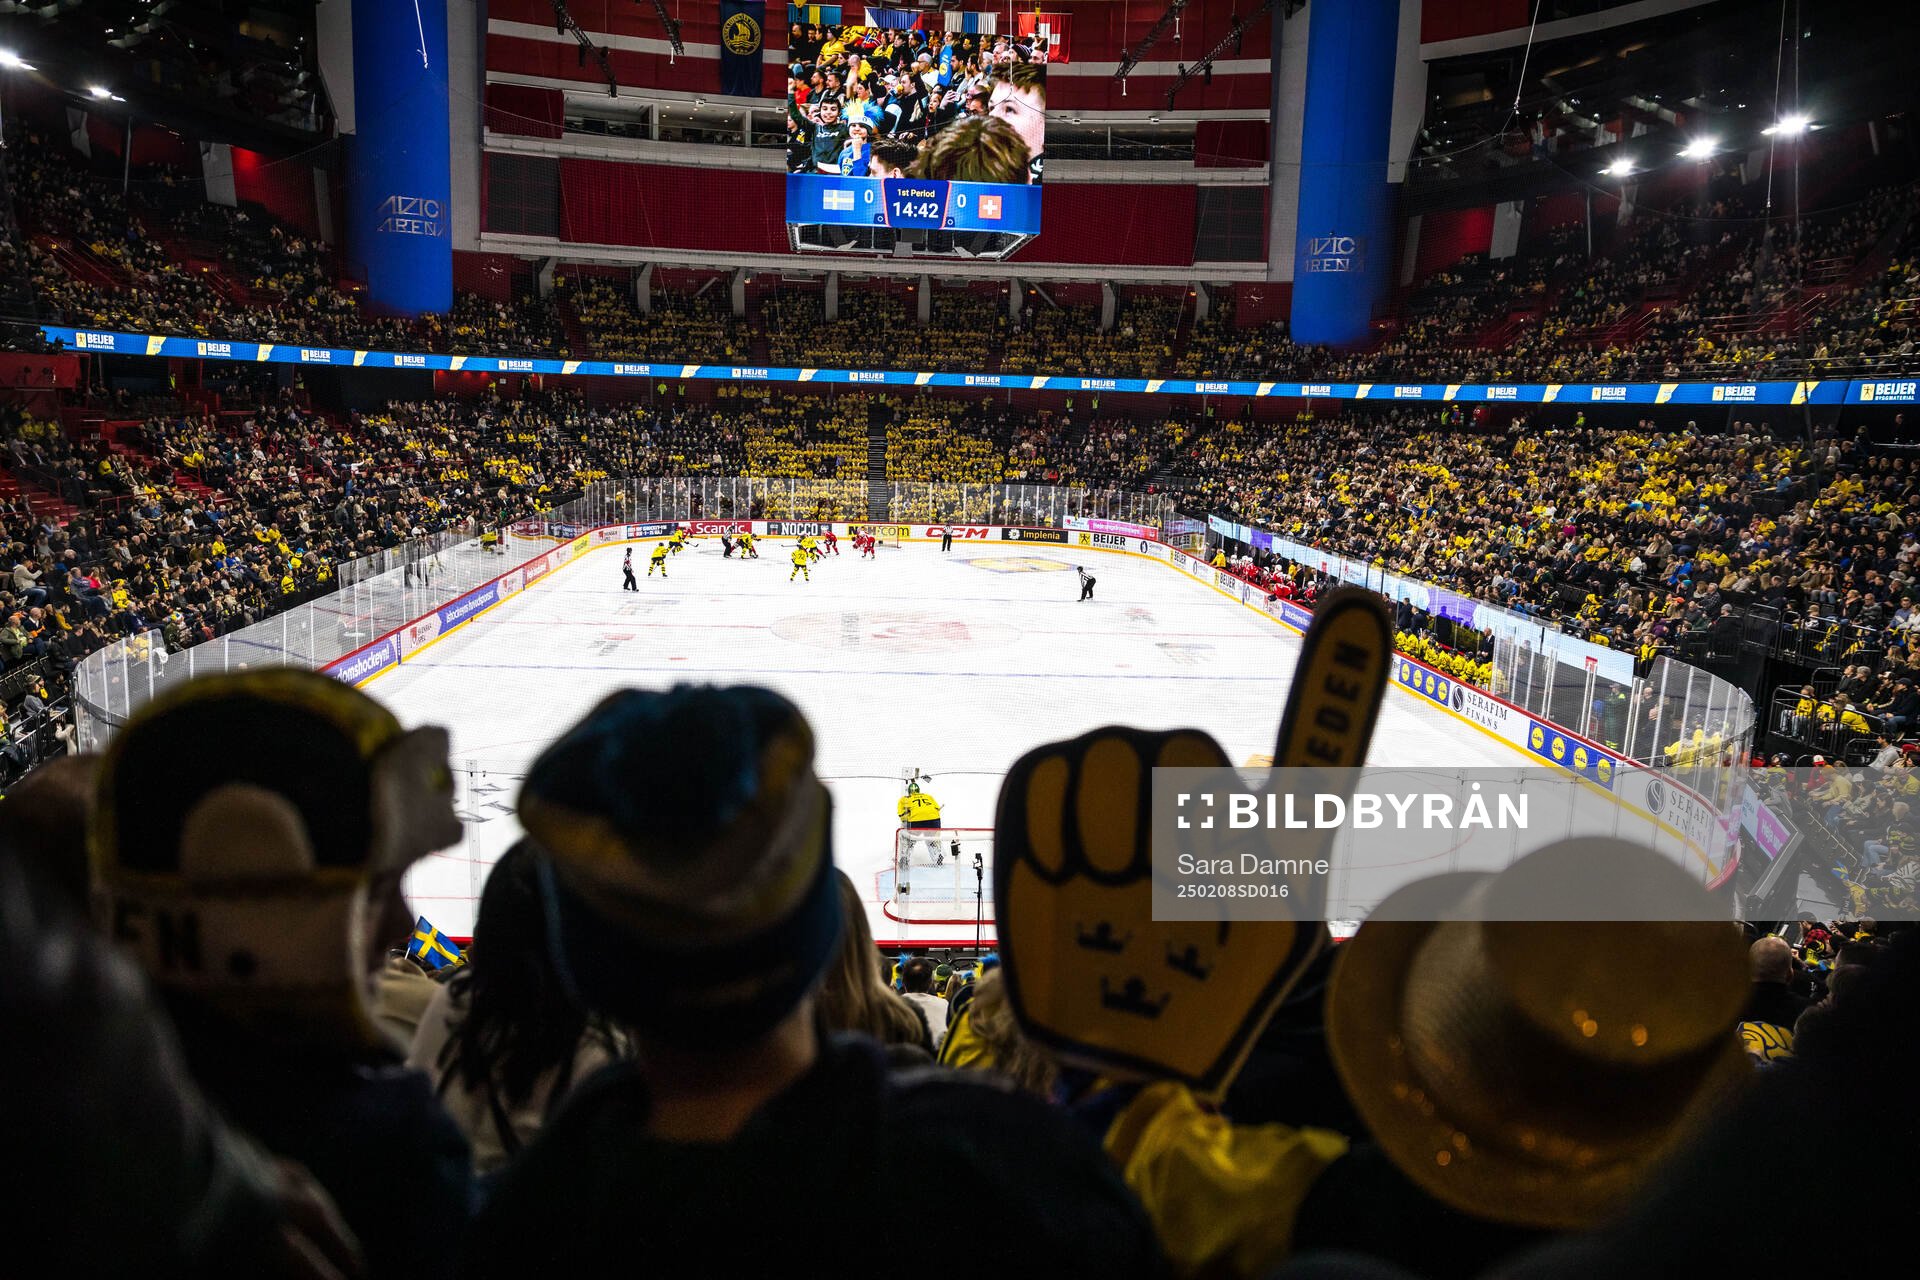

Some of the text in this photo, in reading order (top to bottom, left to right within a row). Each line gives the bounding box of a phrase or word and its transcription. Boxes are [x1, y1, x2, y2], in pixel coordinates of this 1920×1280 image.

[864, 189, 874, 204] 0
[898, 189, 936, 198] 1st Period
[957, 194, 967, 208] 0
[893, 201, 939, 219] 14:42
[87, 333, 114, 345] BEIJER
[207, 342, 231, 353] BEIJER
[1724, 385, 1757, 396] BEIJER
[1875, 382, 1917, 395] BEIJER
[781, 522, 818, 536] NOCCO
[926, 527, 989, 539] CCM
[1023, 530, 1061, 541] Implenia
[1093, 533, 1126, 546] BEIJER
[1219, 572, 1236, 590] BEIJER
[1467, 692, 1508, 721] SERAFIM
[1465, 708, 1498, 730] FINANS
[912, 798, 932, 807] 75
